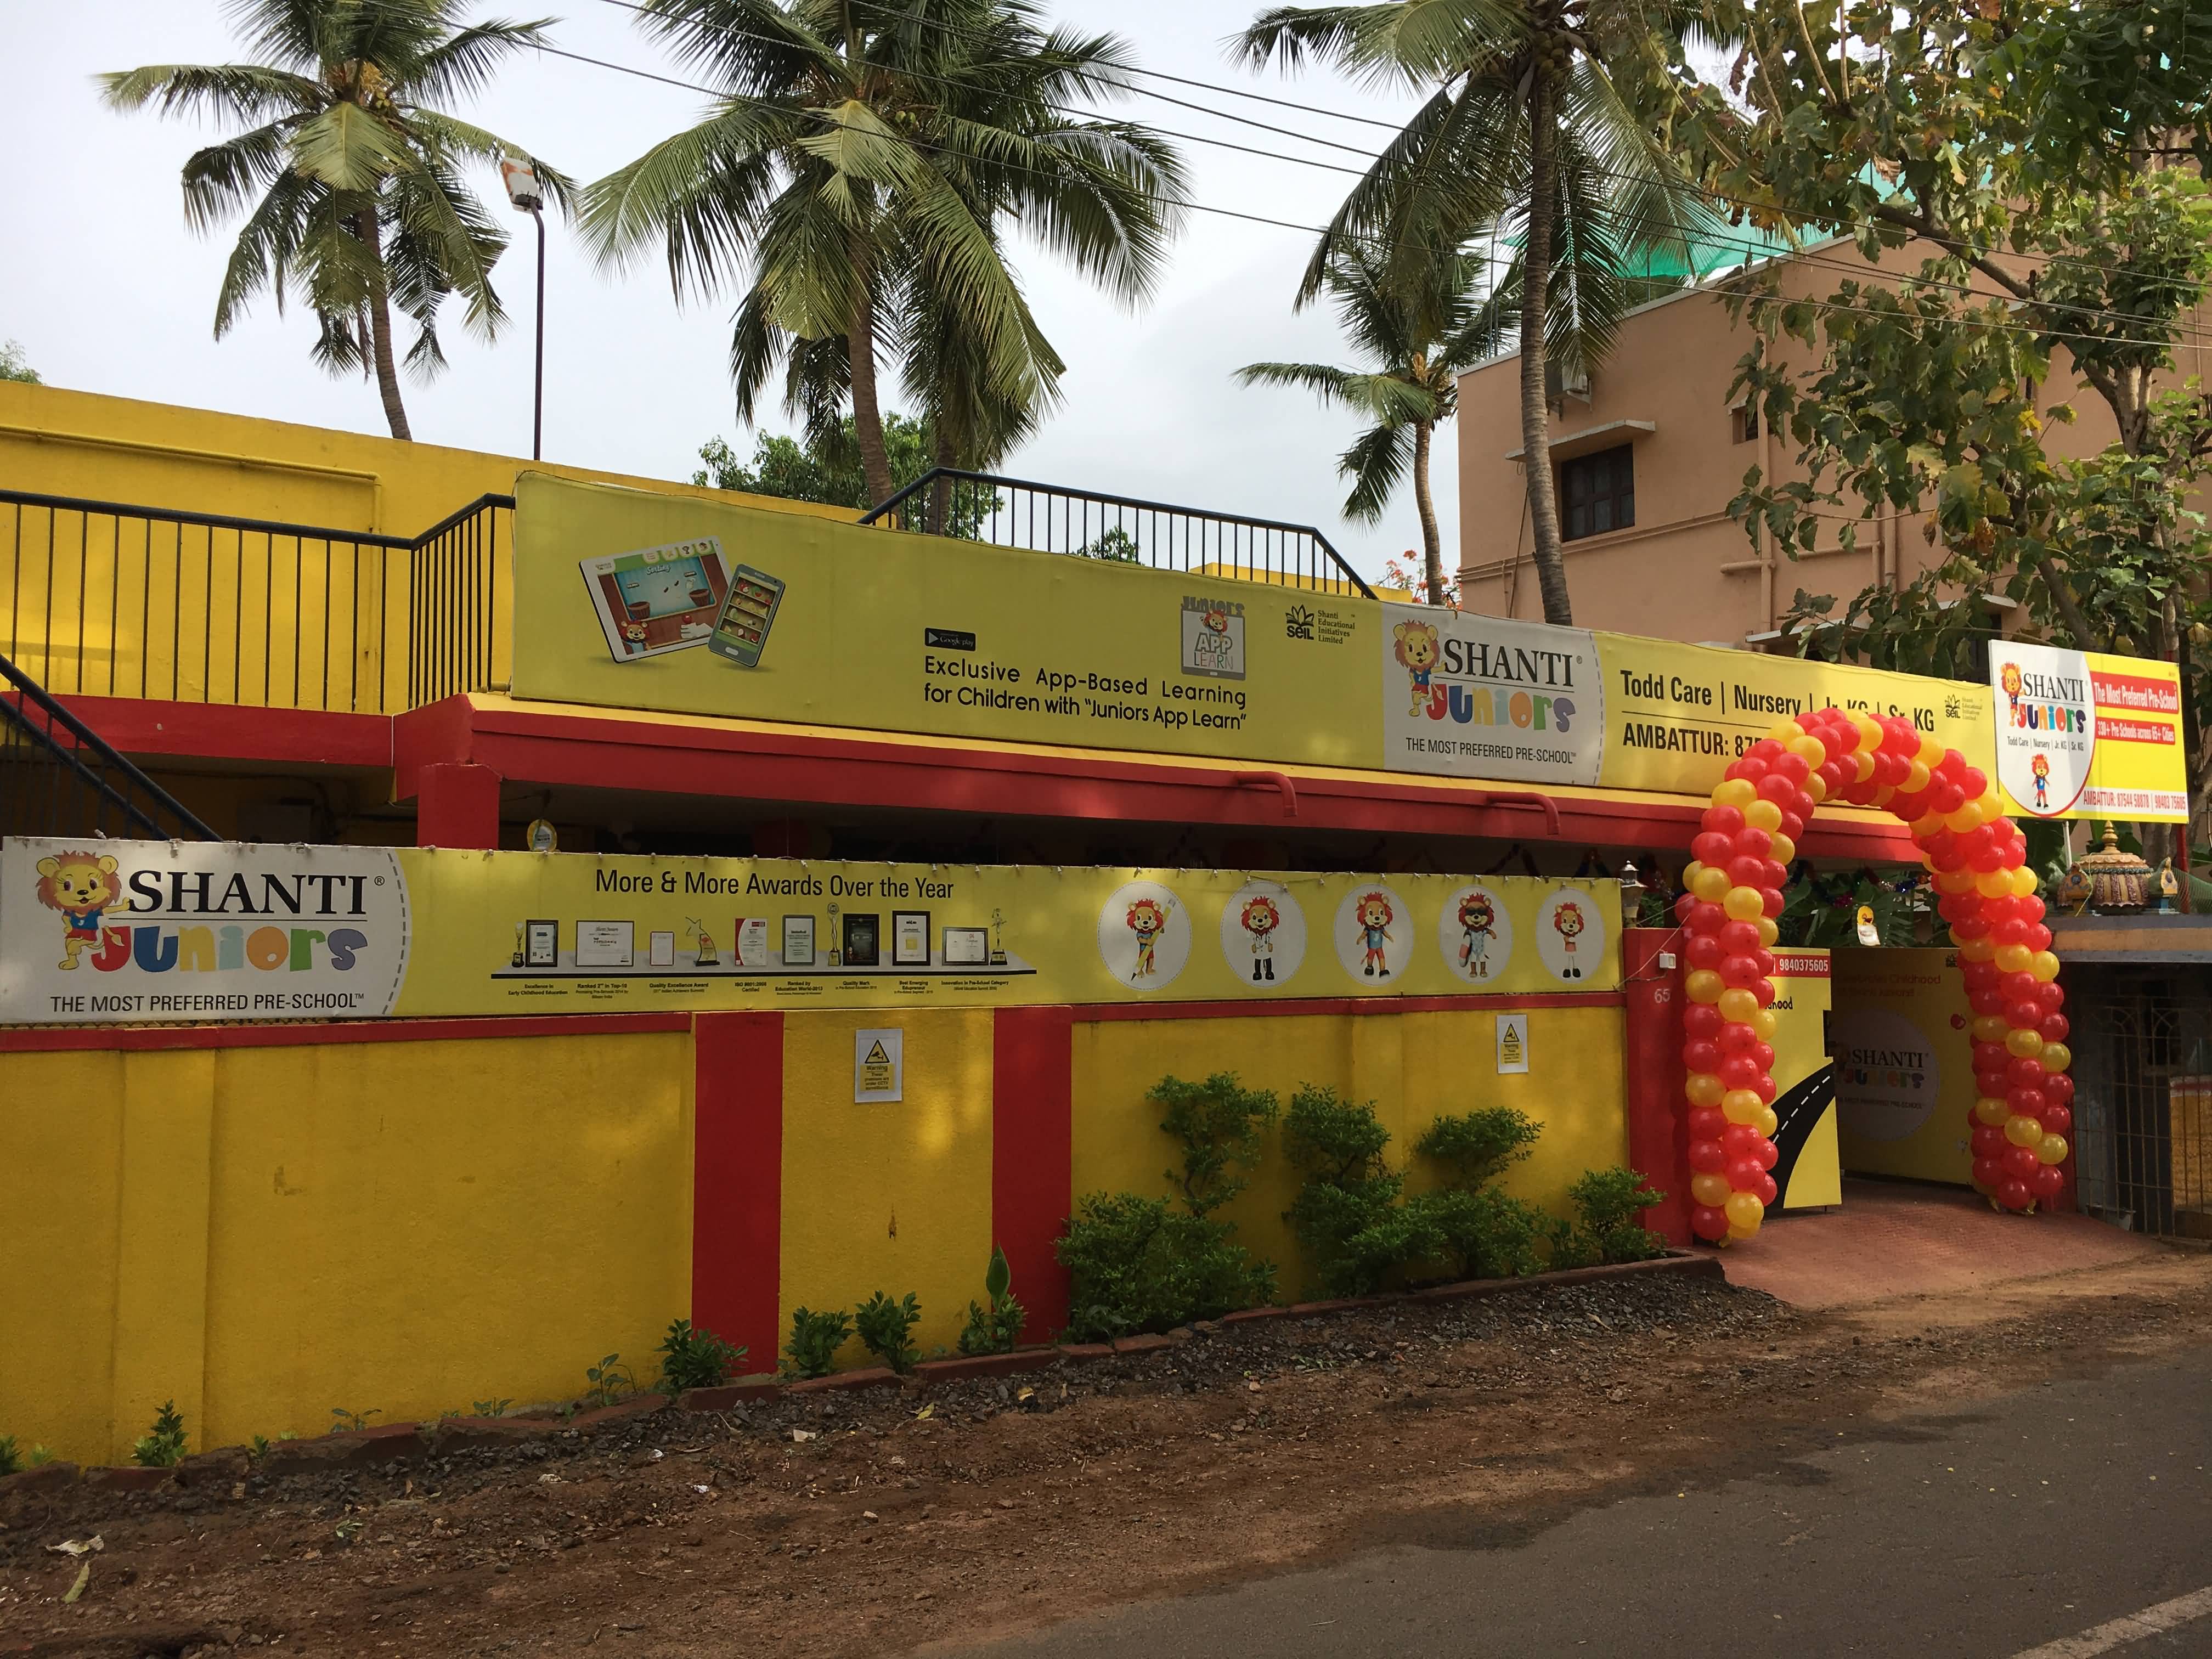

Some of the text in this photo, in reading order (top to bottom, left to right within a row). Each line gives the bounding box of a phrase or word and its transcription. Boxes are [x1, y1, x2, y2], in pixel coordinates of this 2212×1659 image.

[1318, 610, 1339, 619] Shanti
[1318, 618, 1355, 630] Educational
[1318, 627, 1350, 637] Initiatives
[940, 636, 961, 645] Google
[1194, 632, 1233, 654] APP
[1318, 635, 1344, 645] Limited
[1194, 652, 1233, 670] LEARN
[924, 656, 1246, 710] Exclusive App-Based Learning
[1621, 669, 1664, 699] Todd
[1671, 676, 1712, 706] Care
[1734, 684, 1801, 716] Nursery
[2094, 682, 2105, 703] The
[2106, 684, 2121, 704] Most
[2121, 685, 2147, 707] Preferred
[924, 683, 952, 703] for
[957, 686, 1040, 712] Children
[1045, 696, 1080, 715] with
[1153, 706, 1188, 730] App
[1622, 723, 1729, 757] AMBATTUR:
[2119, 723, 2136, 738] Schools
[2137, 727, 2152, 740] across
[1406, 737, 1425, 752] THE
[1429, 740, 1457, 754] MOST
[1460, 742, 1513, 759] PREFERRED
[2007, 736, 2018, 746] Todd
[2018, 737, 2029, 746] Care
[2033, 738, 2050, 751] Nursery
[2061, 741, 2067, 749] KG
[2078, 742, 2084, 751] KG
[596, 868, 954, 899] More & More Awards Over the Year
[1779, 958, 1829, 972] 9840375605
[50, 996, 86, 1012] THE
[91, 995, 144, 1012] MOST
[150, 995, 248, 1012] PREFERRED
[1654, 989, 1671, 1003] 65
[1852, 1048, 1924, 1068] SHANTI
